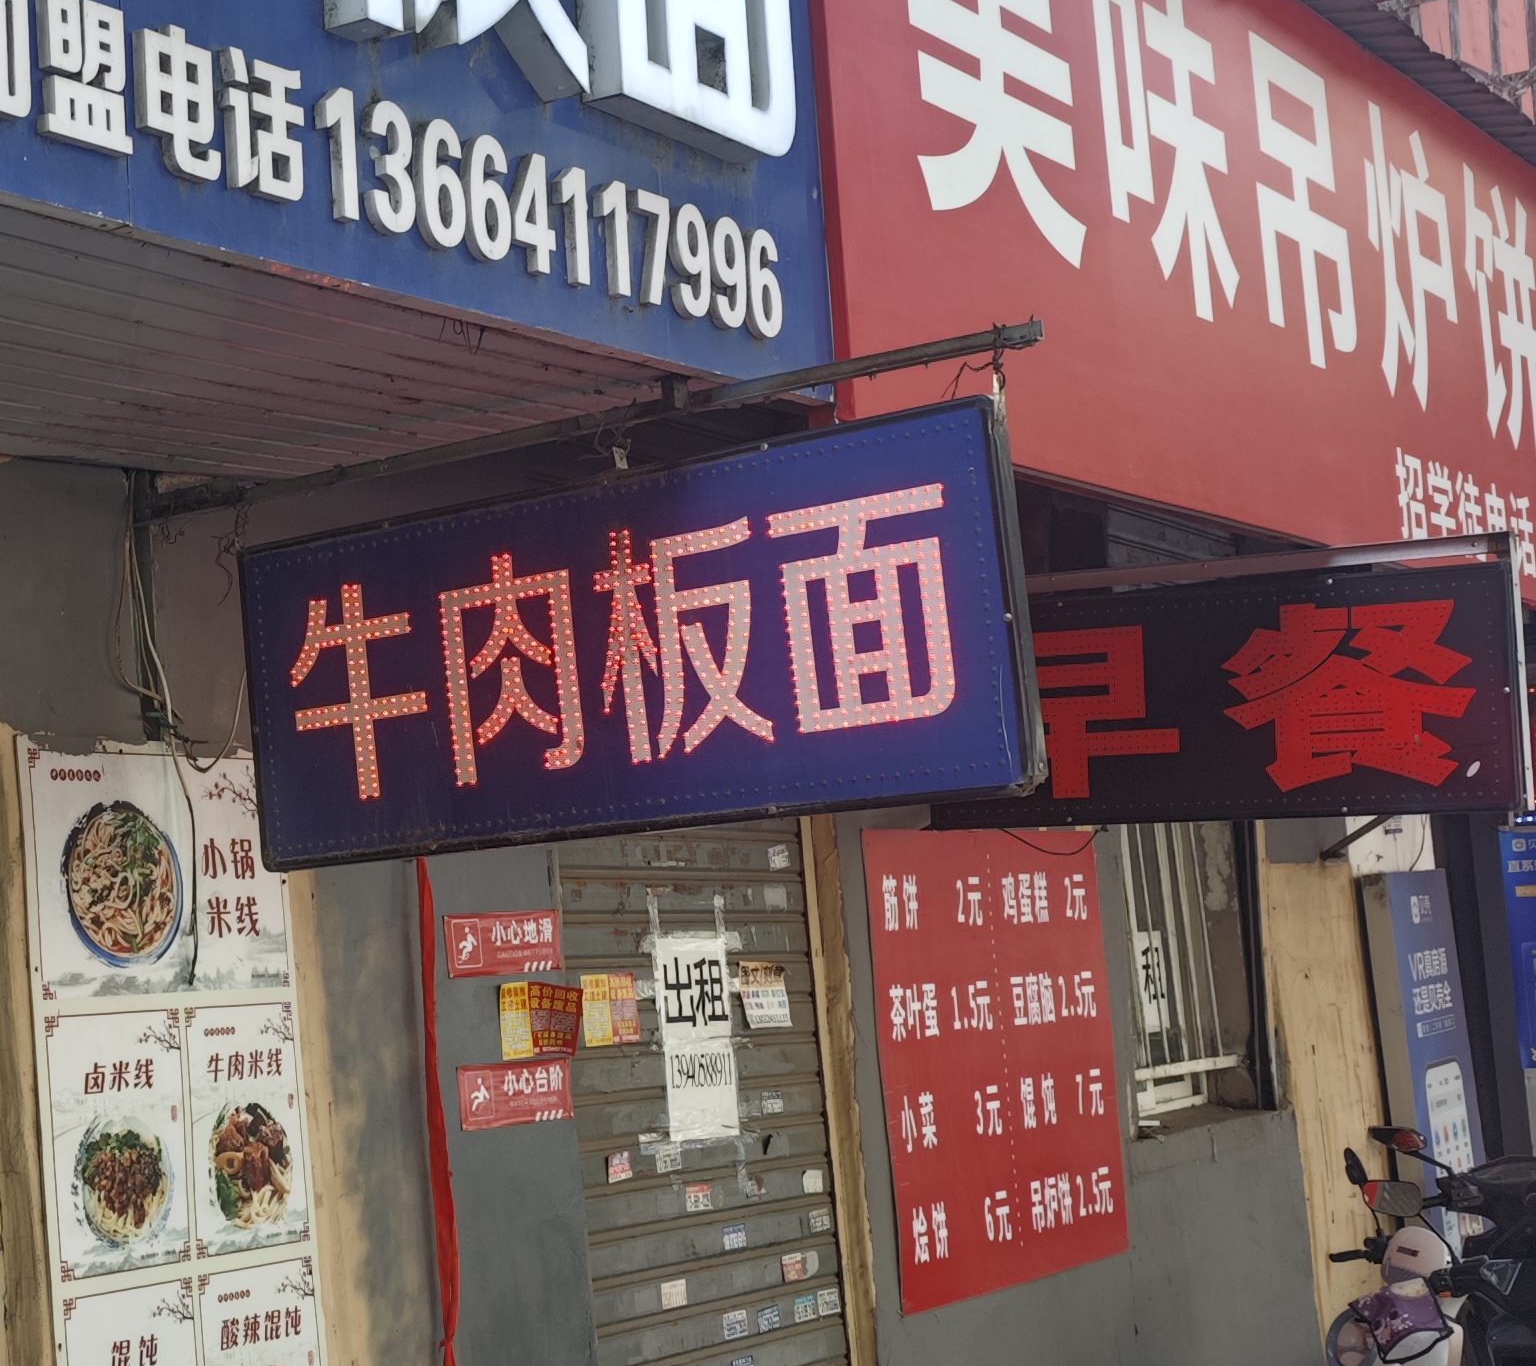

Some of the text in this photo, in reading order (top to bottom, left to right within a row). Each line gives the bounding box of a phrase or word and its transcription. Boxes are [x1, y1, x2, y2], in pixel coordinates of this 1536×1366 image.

[290, 483, 957, 801] 牛肉板面
[1033, 598, 1476, 800] 早餐
[201, 837, 255, 880] 小锅
[206, 896, 260, 938] 米线
[883, 874, 983, 932] 筋饼 2元
[1001, 872, 1088, 924] 鸡蛋糕 2元
[491, 918, 553, 946] 小心地滑
[530, 984, 579, 1002] 高价回收
[663, 957, 729, 1027] 出租
[889, 981, 993, 1042] 茶叶蛋 1.5元
[1010, 971, 1097, 1026] 豆腐脑 2.5元
[84, 1058, 154, 1095] 卤米线
[207, 1047, 283, 1083] 牛肉米线
[504, 1065, 563, 1096] 小心台阶
[901, 1085, 1003, 1153] 小菜 3元
[1020, 1068, 1104, 1129] 馄饨 7元
[1030, 1166, 1113, 1233] 吊炉饼 2.5元
[912, 1190, 1013, 1265] 烩饼 6元
[220, 1306, 302, 1352] 酸辣馄饨
